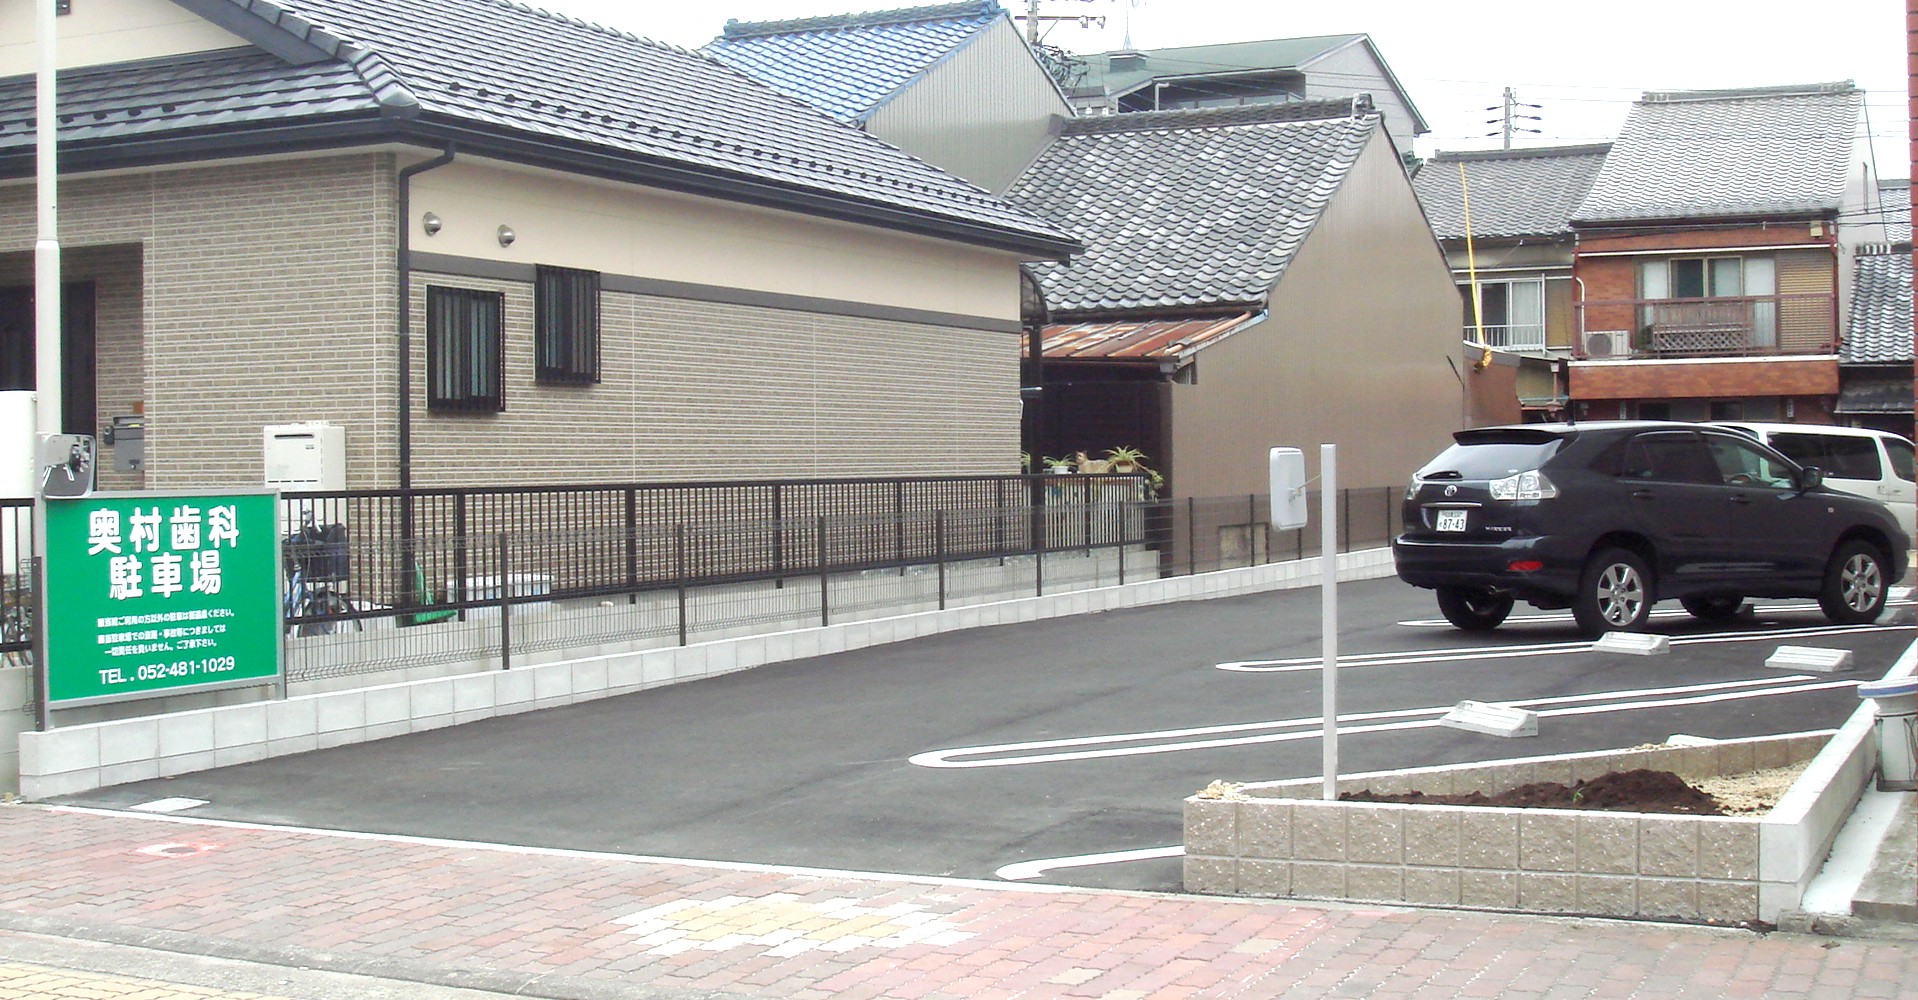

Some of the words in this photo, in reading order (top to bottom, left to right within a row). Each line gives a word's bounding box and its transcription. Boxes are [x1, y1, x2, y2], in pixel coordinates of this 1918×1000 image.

[87, 504, 240, 556] 奥村歯科
[109, 549, 222, 600] 駐車場
[137, 656, 235, 681] 052-481-1029
